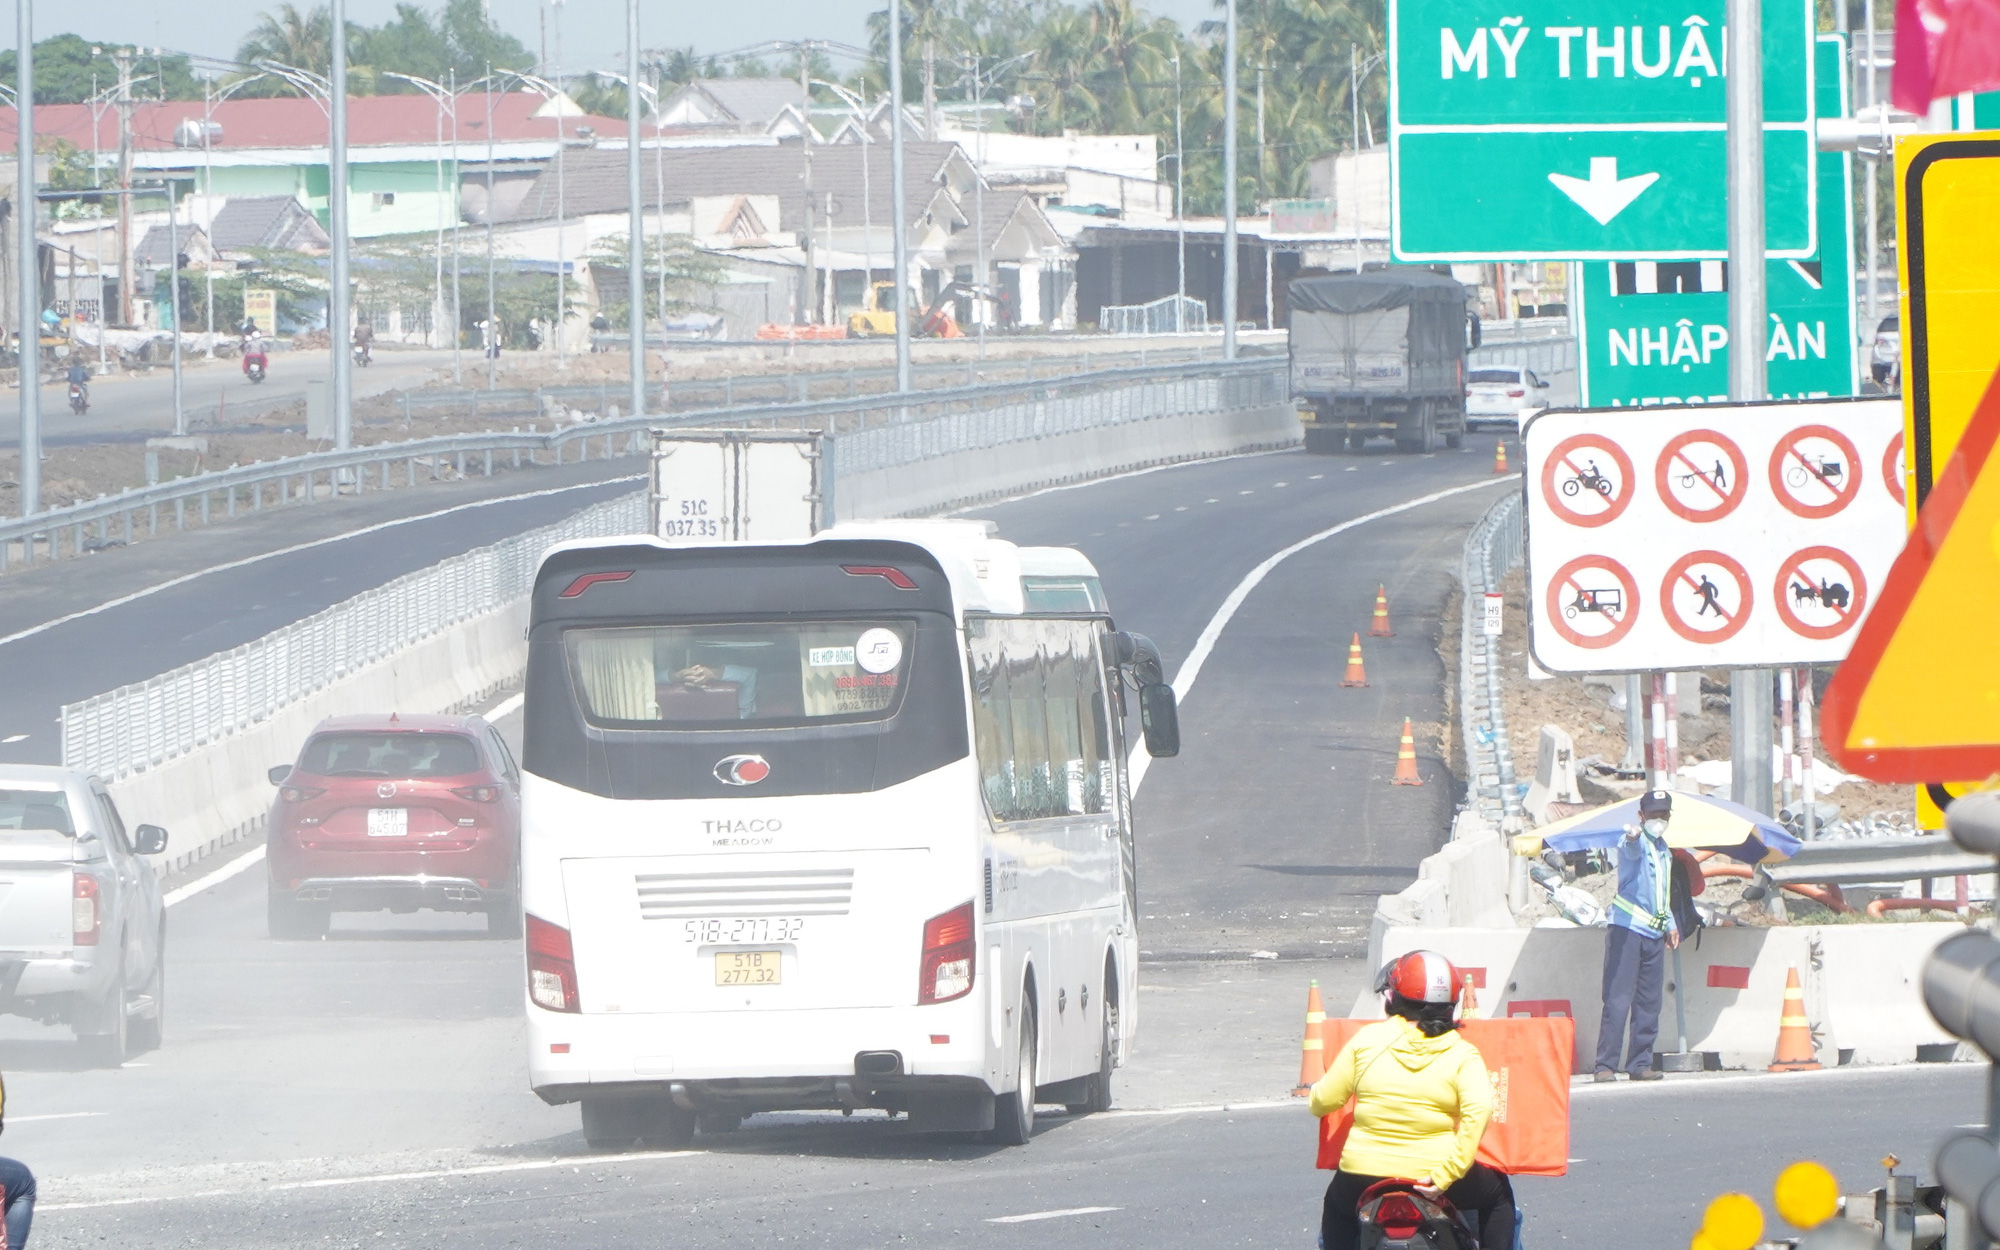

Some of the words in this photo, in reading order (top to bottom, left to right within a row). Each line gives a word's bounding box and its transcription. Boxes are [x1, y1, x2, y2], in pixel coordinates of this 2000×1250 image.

[1440, 15, 1530, 80] MỸ
[1544, 14, 1727, 88] THUẬ
[1608, 318, 1728, 373] NHẬP
[1766, 312, 1826, 362] ÀN
[681, 499, 708, 516] 51C
[665, 518, 717, 537] 037.35
[1487, 606, 1499, 615] H9
[701, 819, 782, 833] THACO
[712, 838, 773, 846] MEADOW
[734, 953, 763, 968] 51B
[723, 968, 775, 983] 277.32
